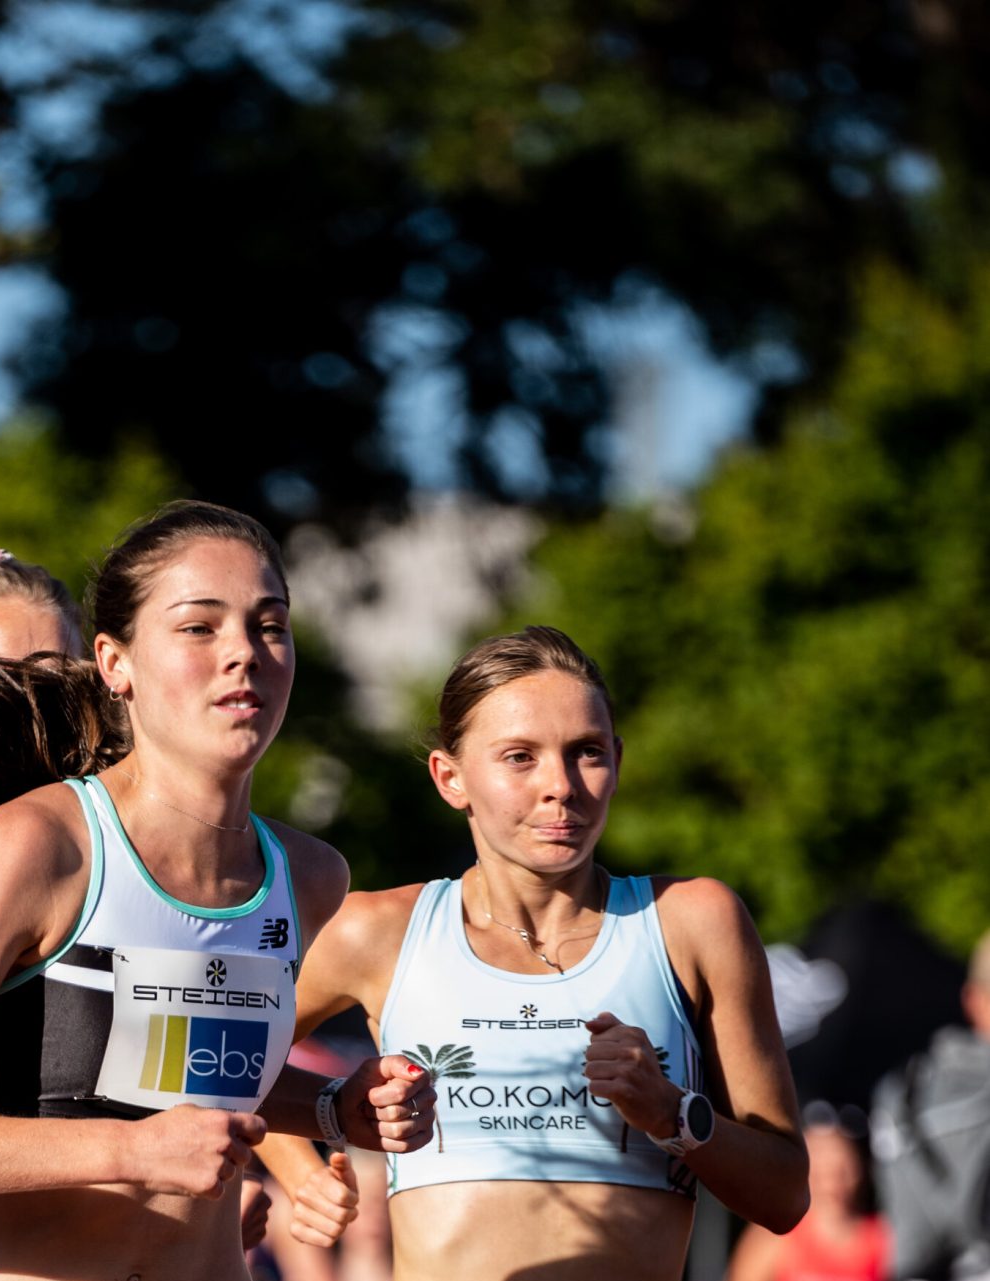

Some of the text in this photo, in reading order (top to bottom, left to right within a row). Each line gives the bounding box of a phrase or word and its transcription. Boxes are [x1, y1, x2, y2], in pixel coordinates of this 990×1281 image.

[133, 984, 281, 1010] STEIGEN
[187, 1030, 265, 1079] ebs
[479, 1115, 587, 1130] SKINCARE
